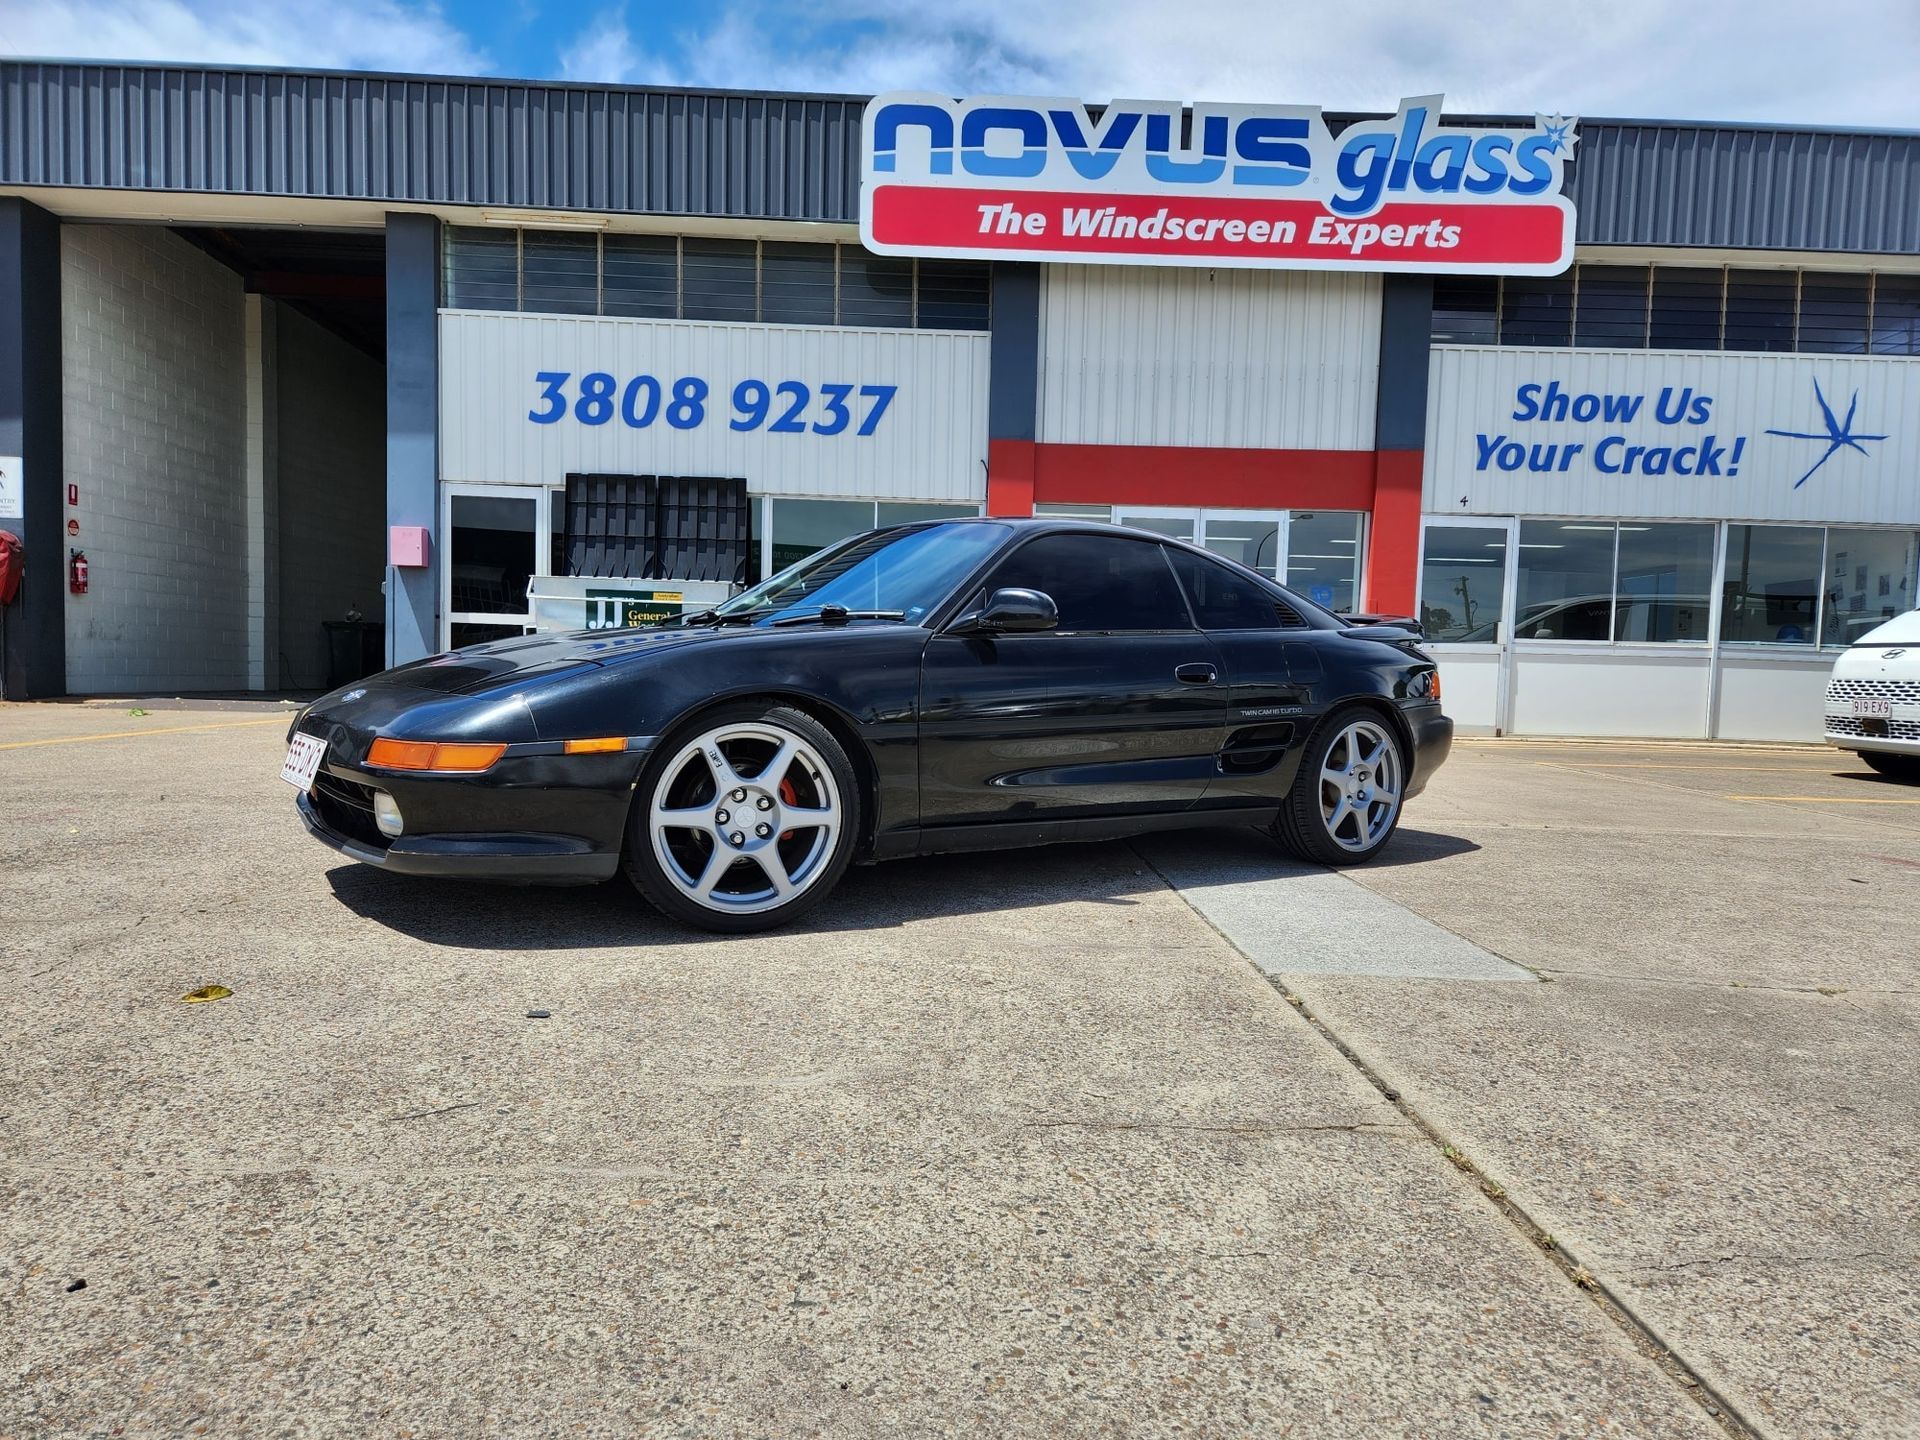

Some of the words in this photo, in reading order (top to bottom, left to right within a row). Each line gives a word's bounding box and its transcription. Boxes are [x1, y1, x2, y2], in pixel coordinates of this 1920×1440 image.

[1330, 106, 1560, 216] glass
[977, 203, 1047, 236] The
[1062, 207, 1297, 244] Windscreen
[1307, 216, 1462, 255] Experts
[528, 371, 709, 430] 3808
[729, 379, 898, 437] 9237
[1512, 381, 1645, 424] Show
[1655, 387, 1713, 426] Us
[1475, 434, 1585, 473] Your
[1594, 435, 1747, 477] Crack!
[1459, 495, 1469, 508] 4
[1854, 701, 1869, 713] 919
[1871, 701, 1889, 713] EX9
